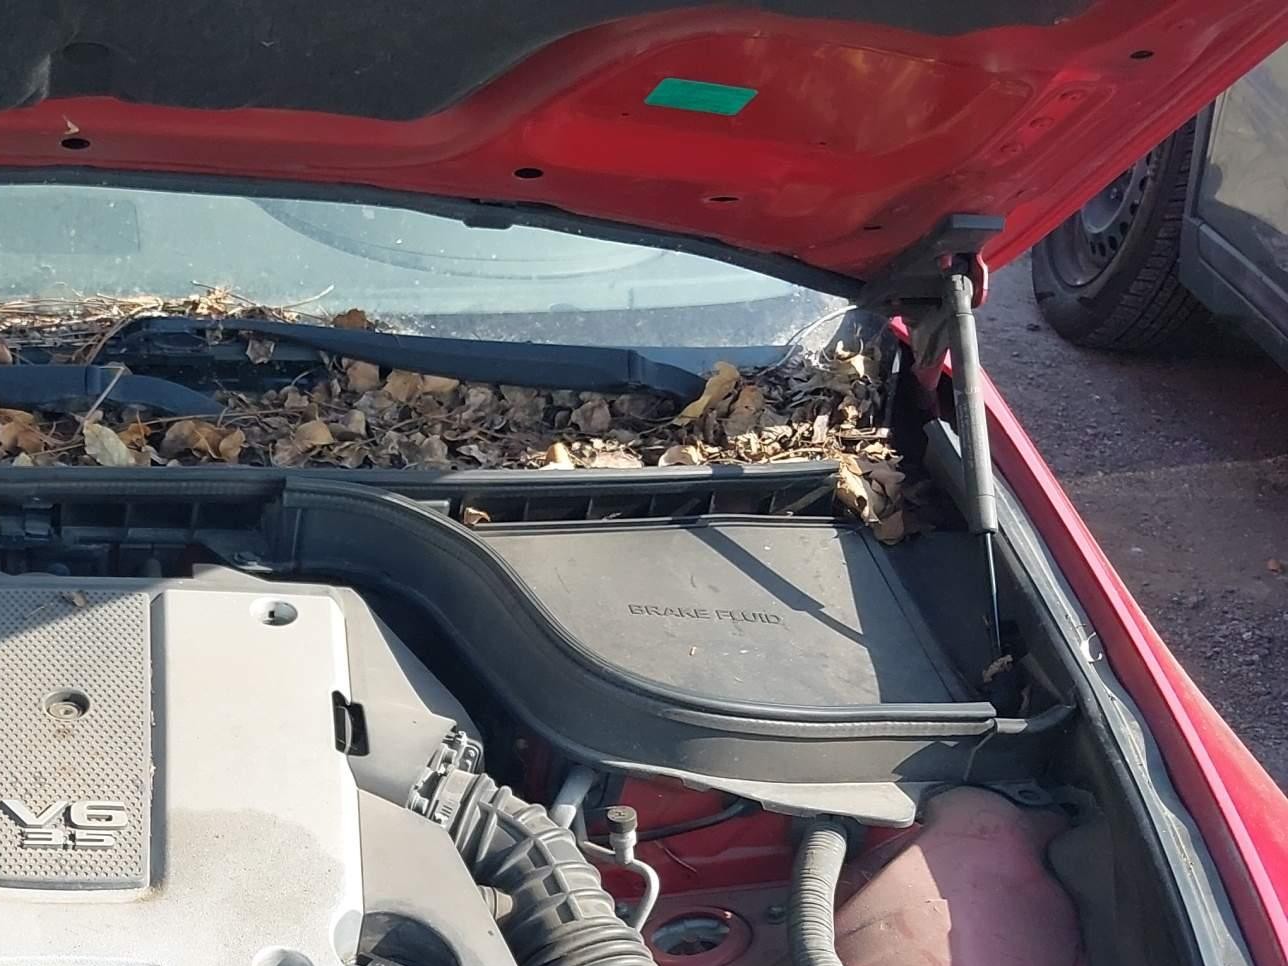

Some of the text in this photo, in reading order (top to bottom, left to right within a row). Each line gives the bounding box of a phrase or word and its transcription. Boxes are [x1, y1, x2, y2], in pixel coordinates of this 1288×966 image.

[627, 603, 784, 625] BRAKE FLUID
[18, 829, 115, 850] 3.5
